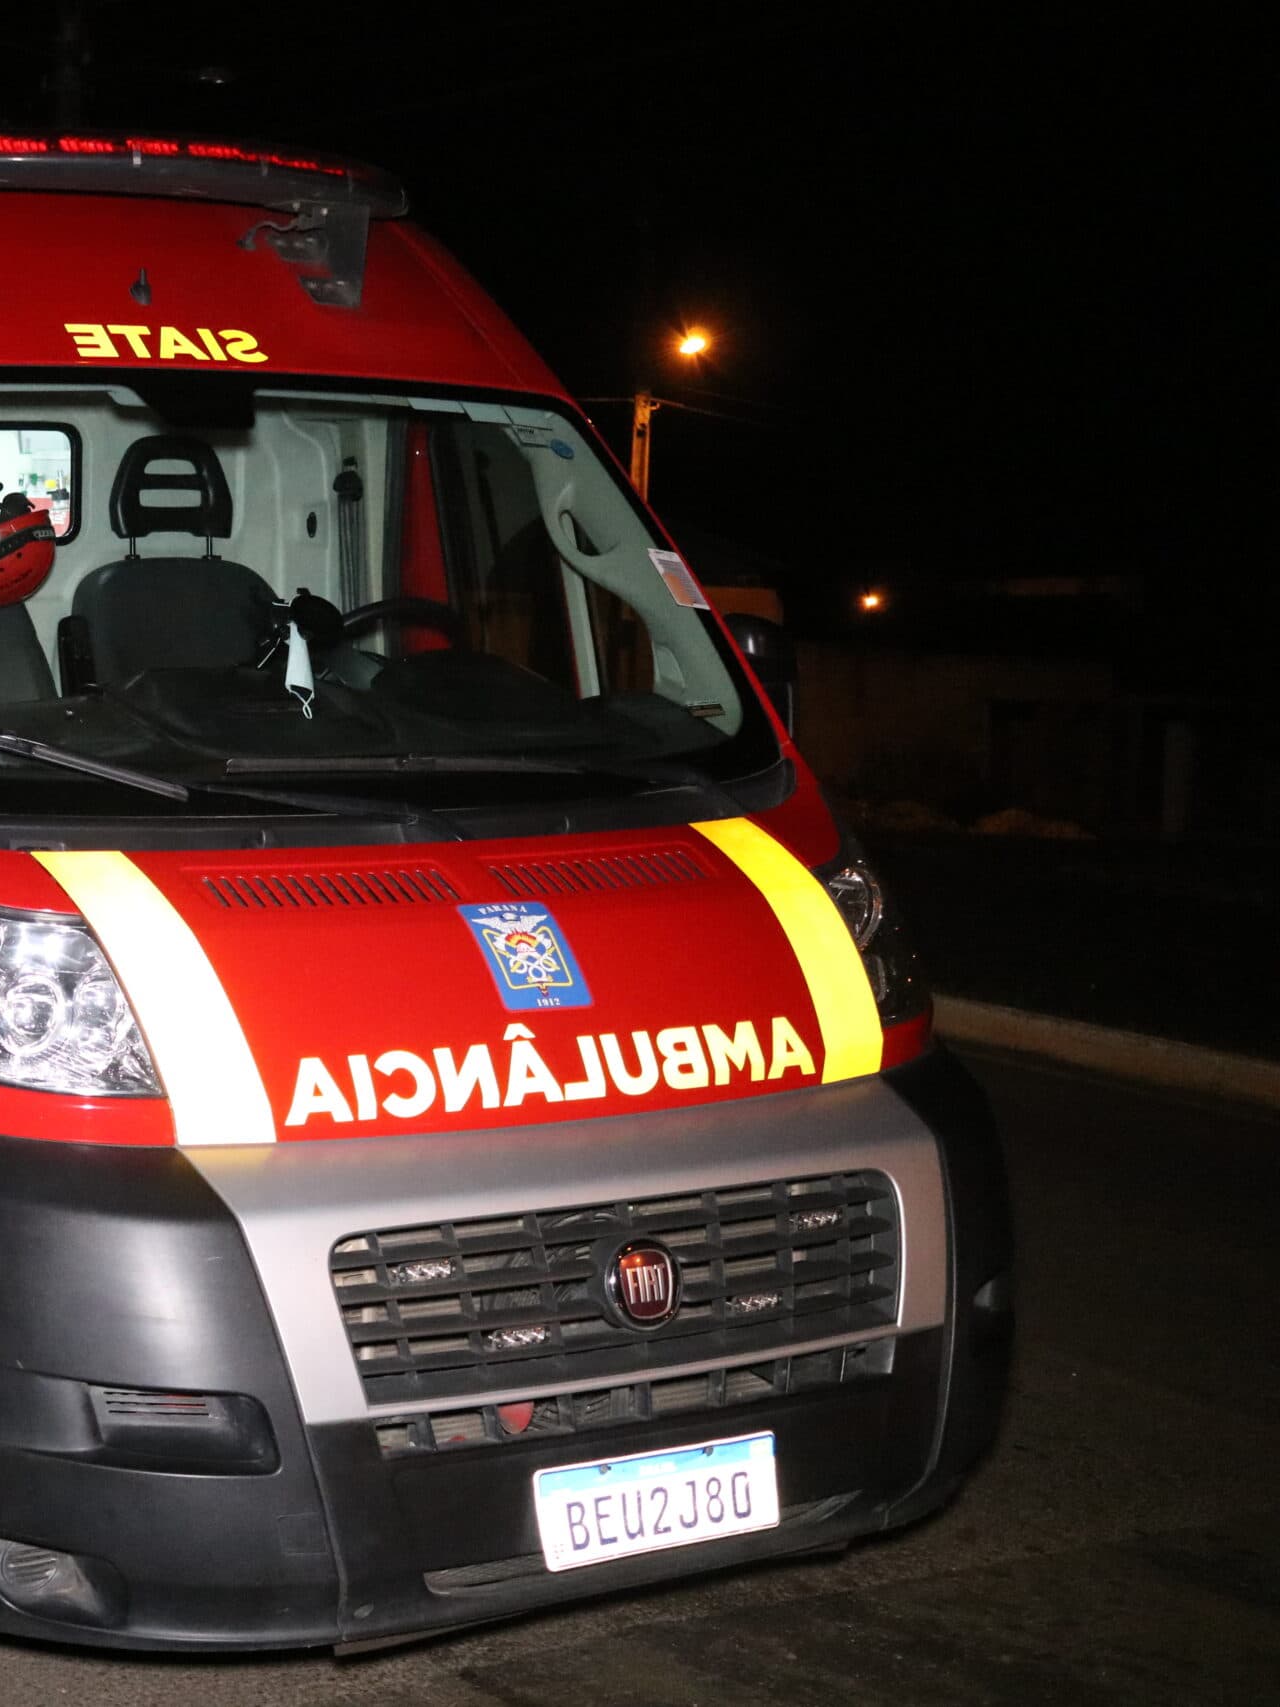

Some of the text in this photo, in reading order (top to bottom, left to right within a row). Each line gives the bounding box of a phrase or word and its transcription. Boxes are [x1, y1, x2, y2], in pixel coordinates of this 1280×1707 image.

[536, 997, 561, 1008] 1912
[625, 1263, 666, 1305] FIAT
[565, 1471, 752, 1551] BEU2J80
